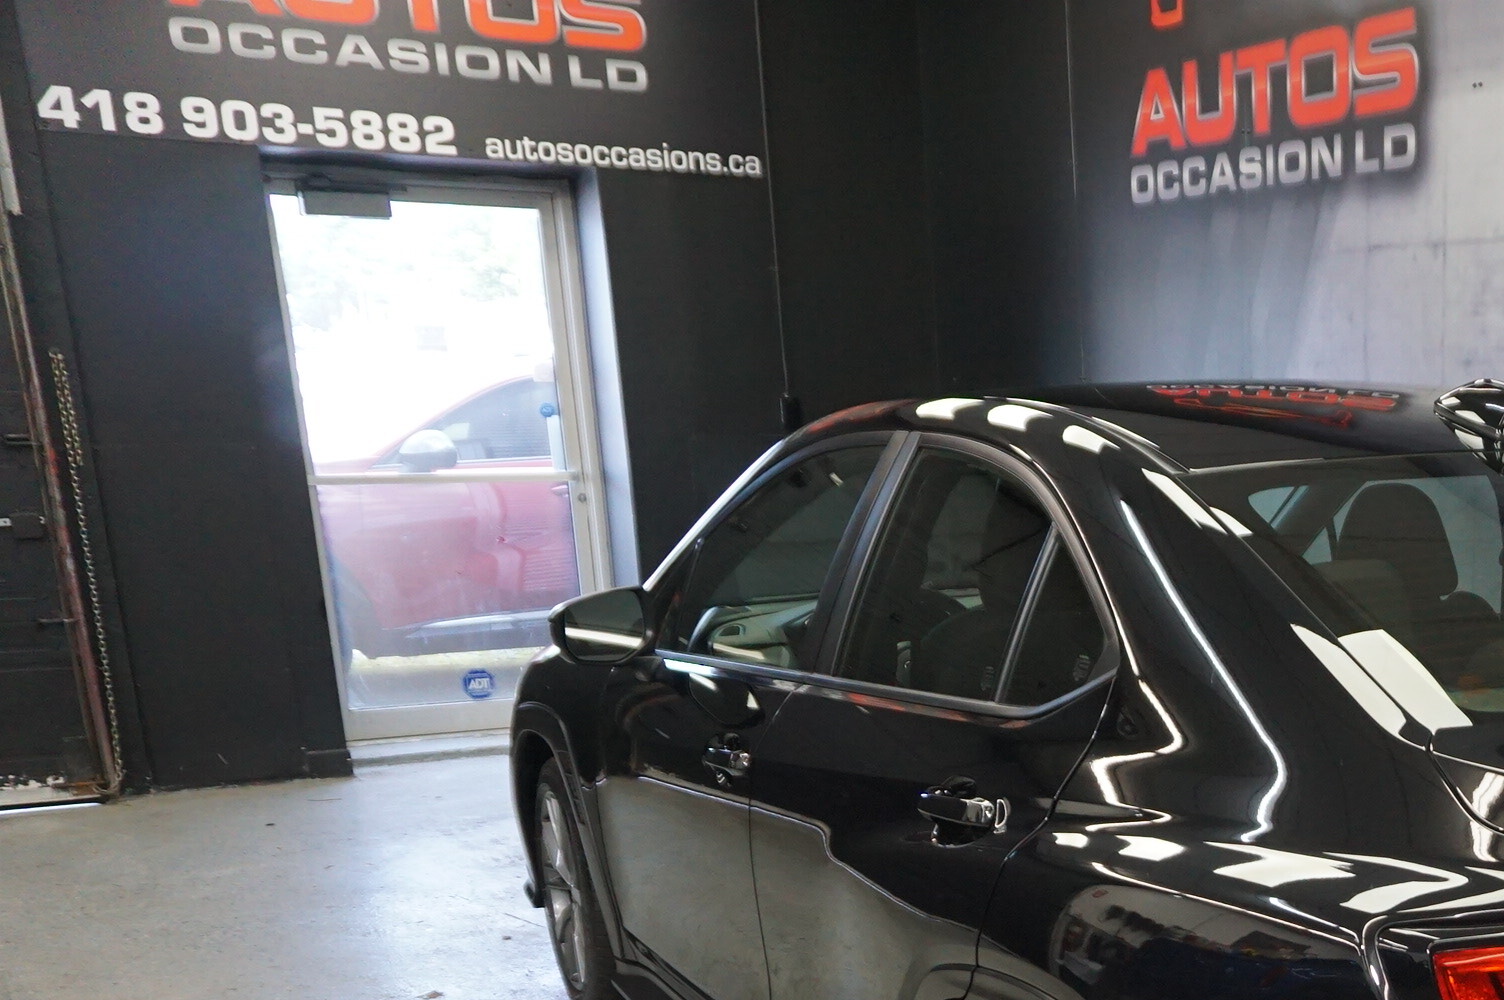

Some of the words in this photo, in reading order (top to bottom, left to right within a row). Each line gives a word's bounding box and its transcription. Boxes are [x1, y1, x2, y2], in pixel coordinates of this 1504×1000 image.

[167, 16, 553, 86] OCCASION
[568, 55, 648, 93] LD
[1131, 7, 1419, 156] AUTOS
[37, 85, 164, 135] 418
[181, 96, 458, 156] 903-5882
[485, 133, 763, 178] autosoccasions.ca
[1130, 132, 1343, 207] OCCASION
[1354, 122, 1417, 174] LD
[468, 677, 490, 690] ADT
